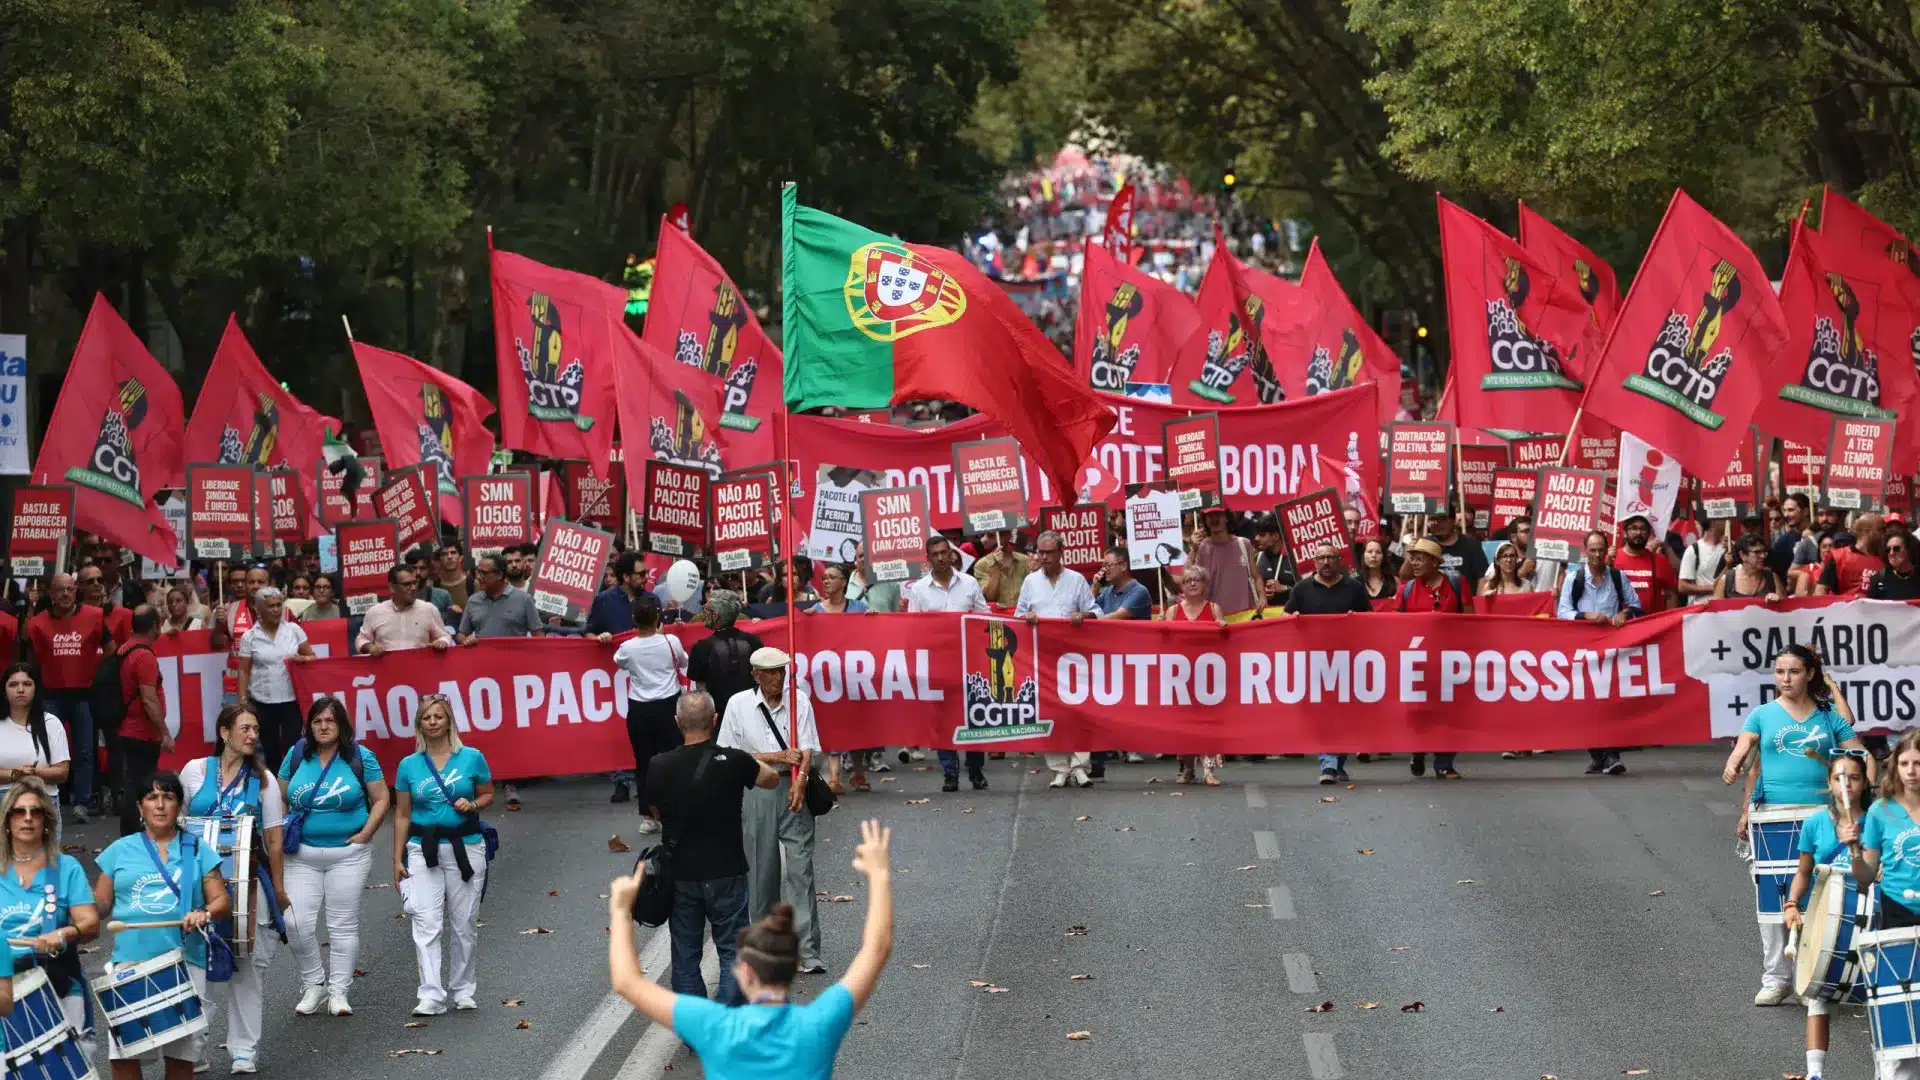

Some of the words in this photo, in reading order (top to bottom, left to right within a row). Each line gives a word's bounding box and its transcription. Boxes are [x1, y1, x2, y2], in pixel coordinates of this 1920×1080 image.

[1648, 347, 1716, 402] CGTP
[1808, 357, 1879, 401] CGTP
[1395, 430, 1445, 442] CONTRATAÇÃO
[1845, 423, 1880, 438] DIREITO
[1520, 442, 1541, 462] NÃO
[1545, 443, 1560, 459] AO
[1847, 438, 1855, 450] A
[1856, 438, 1873, 451] TER
[95, 444, 140, 490] CGT
[968, 458, 995, 470] BASTA
[996, 455, 1008, 467] DE
[1463, 460, 1486, 472] BASTA
[1844, 451, 1874, 465] TEMPO
[962, 467, 1018, 484] EMPOBRECER
[1169, 460, 1216, 477] CONSTITUCIONAL
[1830, 464, 1855, 478] PARA
[1856, 466, 1883, 480] VIVER
[202, 480, 240, 490] LIBERDADE
[656, 468, 681, 488] NÃO
[683, 474, 700, 491] AO
[964, 485, 971, 497] A
[971, 479, 1020, 496] TRABALHAR
[1548, 473, 1575, 494] NÃO
[1576, 478, 1595, 495] AO
[1727, 474, 1753, 487] VIVER
[205, 490, 237, 501] SINDICAL
[480, 483, 514, 502] SMN
[654, 487, 700, 510] PACOTE
[718, 483, 741, 504] NÃO
[745, 483, 761, 500] AO
[820, 490, 847, 502] PACOTE
[1464, 484, 1492, 495] TRABAL
[23, 503, 49, 514] BASTA
[49, 503, 60, 514] DE
[205, 500, 210, 511] É
[211, 501, 238, 511] DIREITO
[718, 501, 763, 523] PACOTE
[877, 494, 911, 516] SMN
[1133, 503, 1157, 512] PACOTE
[1287, 503, 1314, 526] NÃO
[1313, 498, 1333, 518] AO
[1544, 493, 1593, 513] PACOTE
[14, 515, 67, 527] EMPOBRECER
[192, 511, 250, 523] CONSTITUCIONAL
[475, 505, 522, 525] 1050€
[649, 504, 703, 528] LABORAL
[824, 509, 850, 521] PERIGO
[1051, 511, 1079, 530] NÃO
[1080, 511, 1098, 527] AO
[1134, 511, 1160, 521] LABORAL
[1537, 510, 1592, 532] LABORAL
[12, 528, 19, 539] A
[472, 525, 523, 539] (JAN/2026)
[715, 520, 769, 541] LABORAL
[816, 519, 862, 533] CONSTITUCIO
[873, 516, 921, 539] 1050€
[1135, 530, 1156, 539] SOCIAL
[1291, 516, 1339, 545] PACOTE
[349, 539, 374, 552] BASTA
[375, 537, 387, 549] DE
[554, 528, 581, 550] NÃO
[582, 536, 601, 555] AO
[871, 537, 923, 555] (JAN/2026)
[1059, 529, 1100, 547] ACOTE
[343, 549, 394, 566] EMPOBRECER
[548, 546, 598, 573] PACOTE
[1061, 547, 1104, 565] BORAL
[343, 568, 349, 579] A
[538, 562, 594, 592] LABORAL
[1711, 640, 1731, 661] +
[1742, 616, 1889, 669] SALÁRIO
[1056, 652, 1227, 706] OUTRO
[1240, 649, 1386, 705] RUMO
[1400, 636, 1428, 702] É
[1440, 643, 1676, 702] POSSÍVEL
[439, 678, 502, 733] AO
[513, 668, 631, 728] PAC
[785, 648, 944, 703] BORAL
[1728, 695, 1748, 716] +
[968, 703, 1035, 727] CGTP
[960, 728, 1009, 739] INTERSINDICAL
[1010, 726, 1046, 736] NACIONAL
